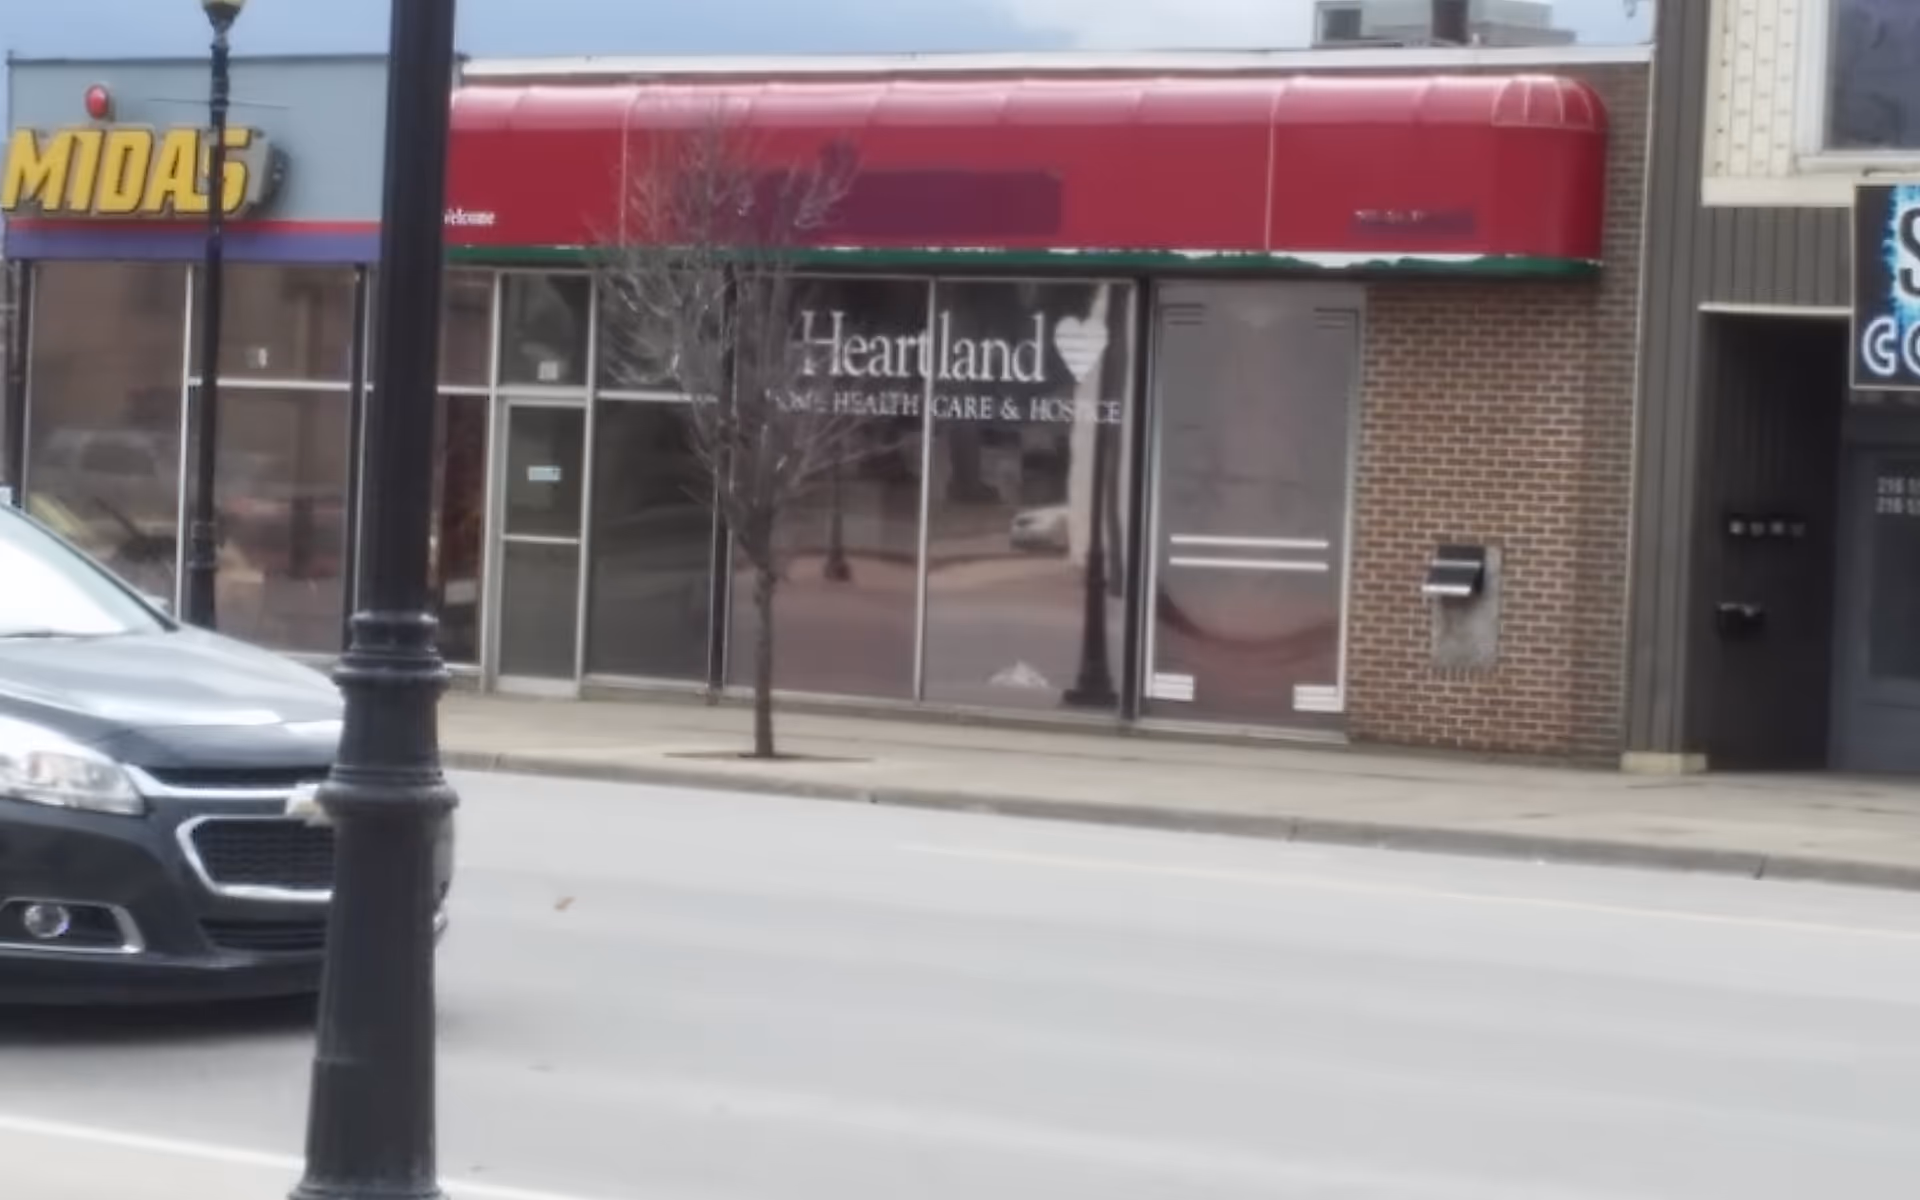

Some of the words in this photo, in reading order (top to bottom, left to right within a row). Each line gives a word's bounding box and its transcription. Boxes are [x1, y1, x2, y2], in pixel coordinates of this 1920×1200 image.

[2, 125, 251, 213] MIDAS
[801, 310, 1046, 383] Heartland
[833, 391, 919, 416] HEALTH
[933, 396, 993, 420] CARE
[1001, 397, 1021, 420] &
[1029, 398, 1122, 424] HOSCE
